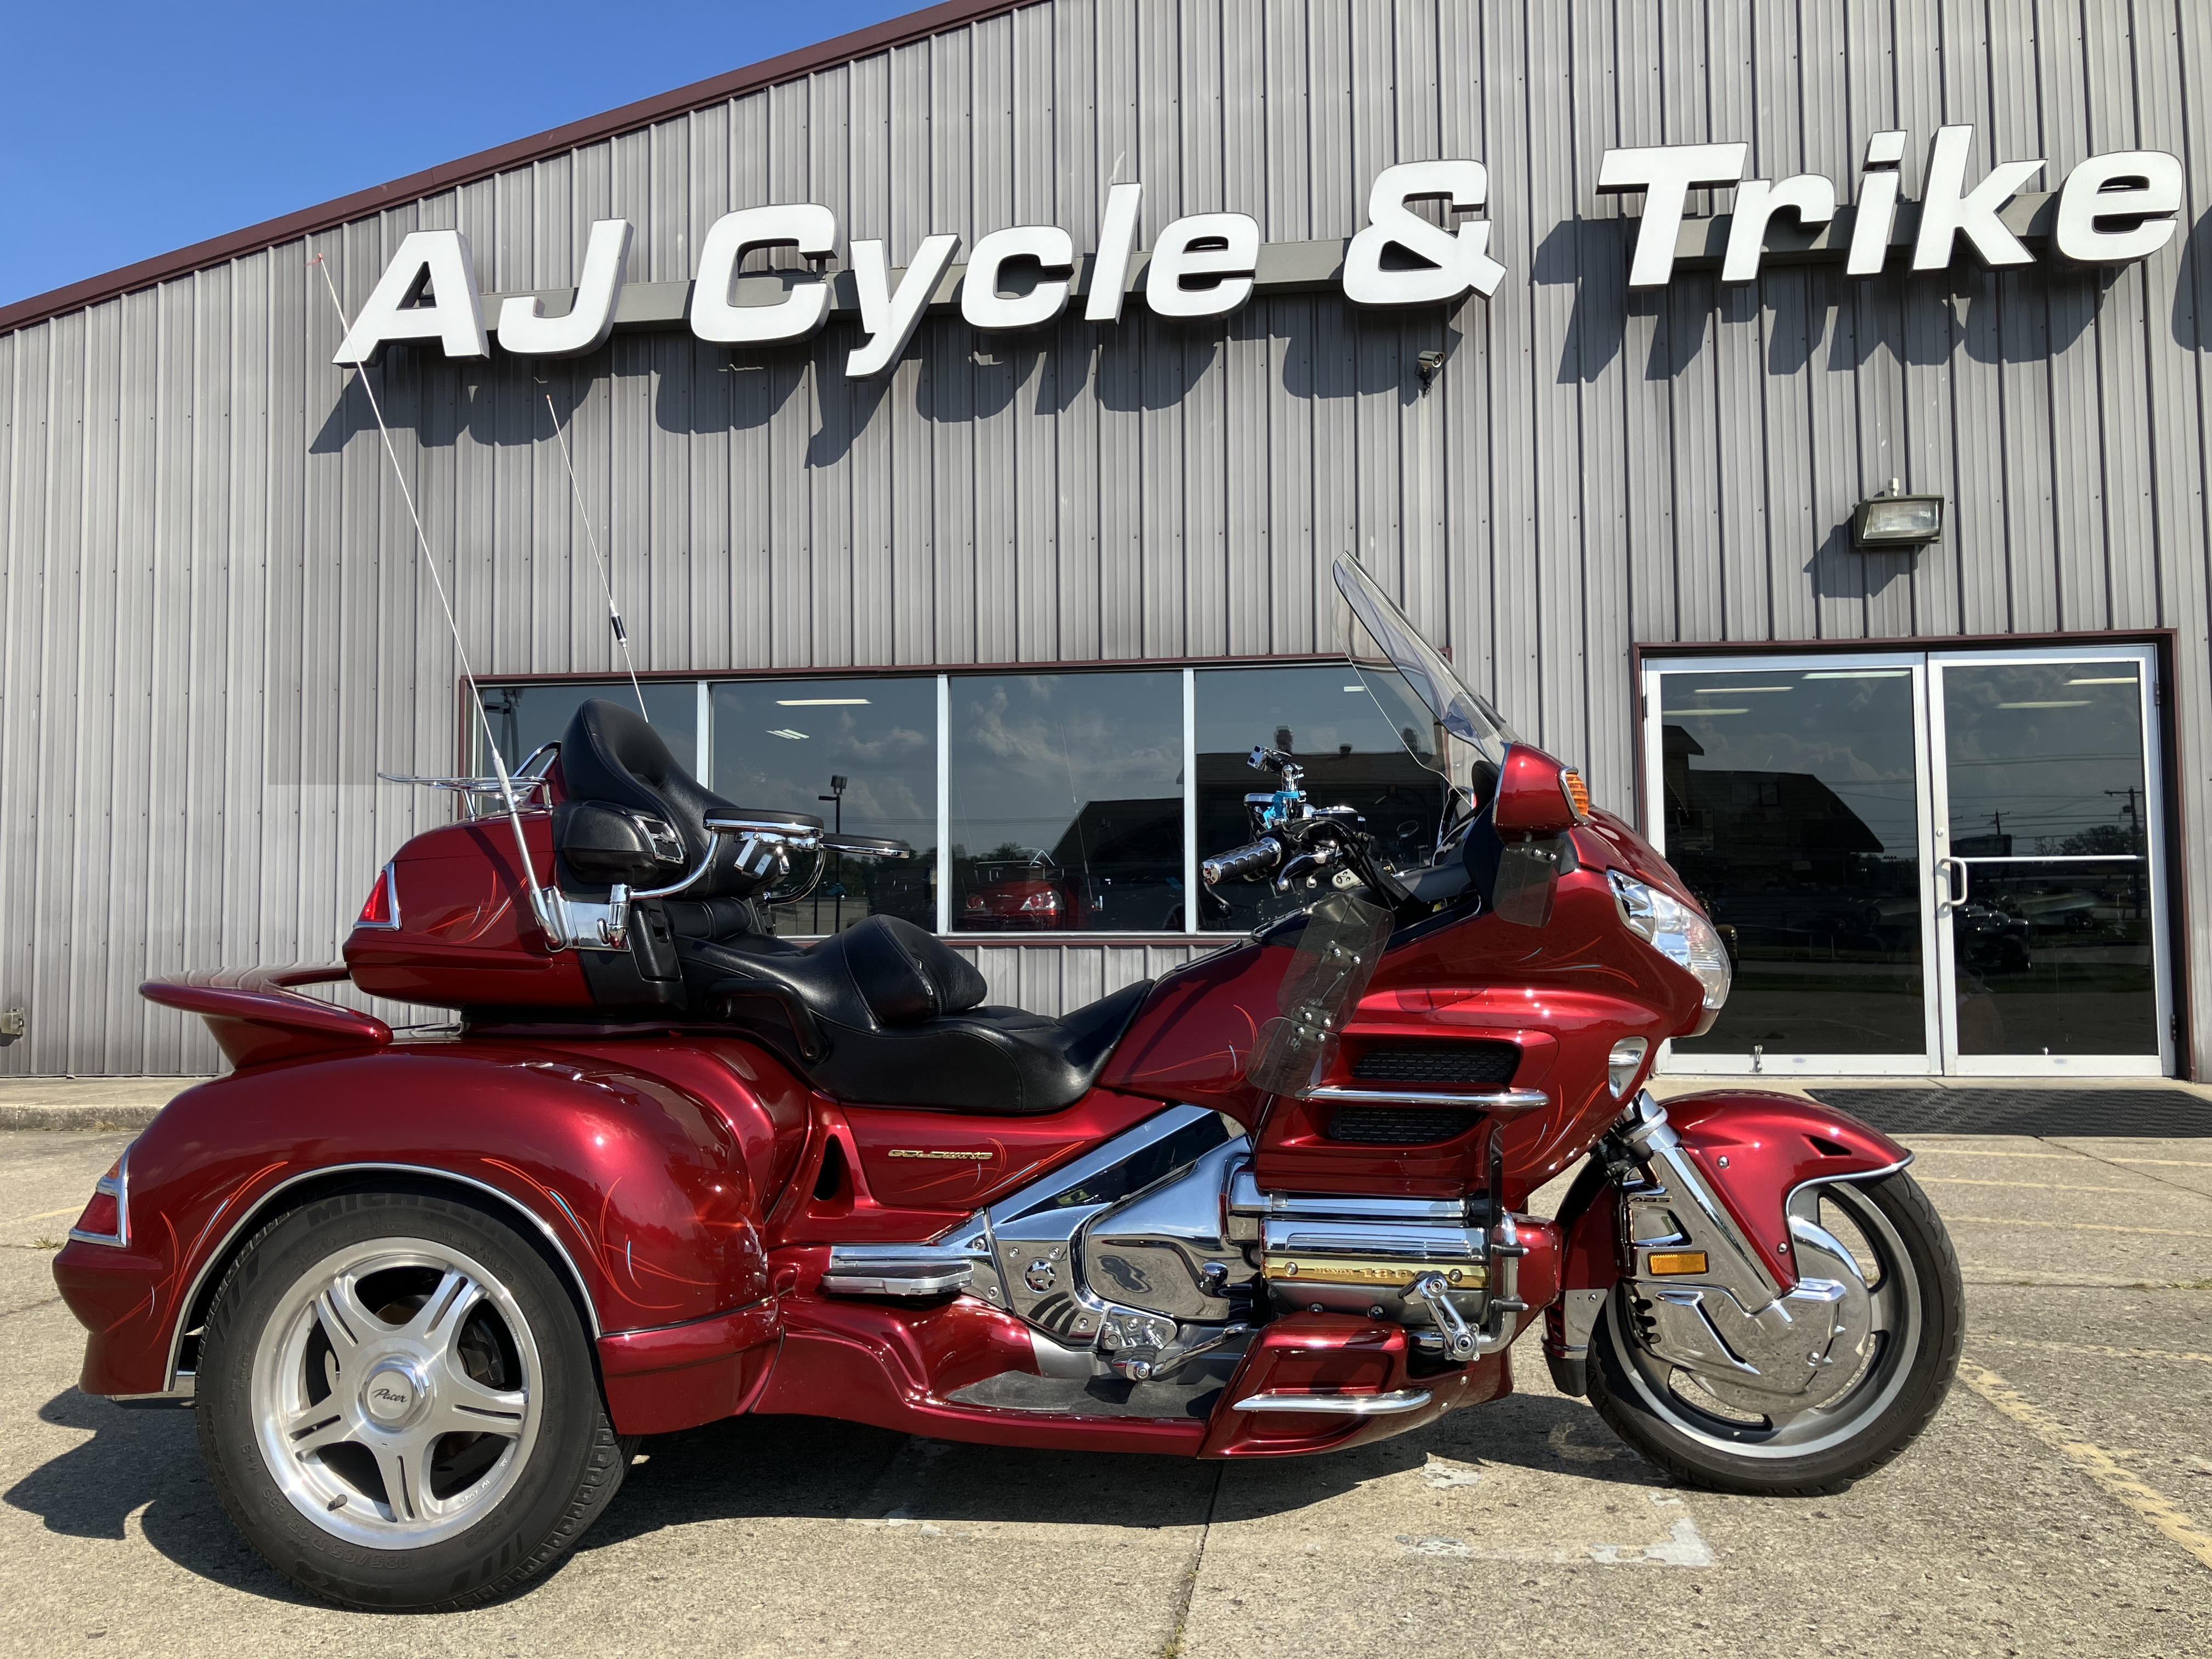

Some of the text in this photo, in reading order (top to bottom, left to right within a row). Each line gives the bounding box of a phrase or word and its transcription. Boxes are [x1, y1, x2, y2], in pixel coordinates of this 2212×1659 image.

[690, 182, 1260, 380] Cycle
[1344, 159, 1507, 308] &
[1595, 124, 2183, 289] Trike
[1313, 1267, 1355, 1276] HONDA
[372, 1389, 407, 1402] Pacer
